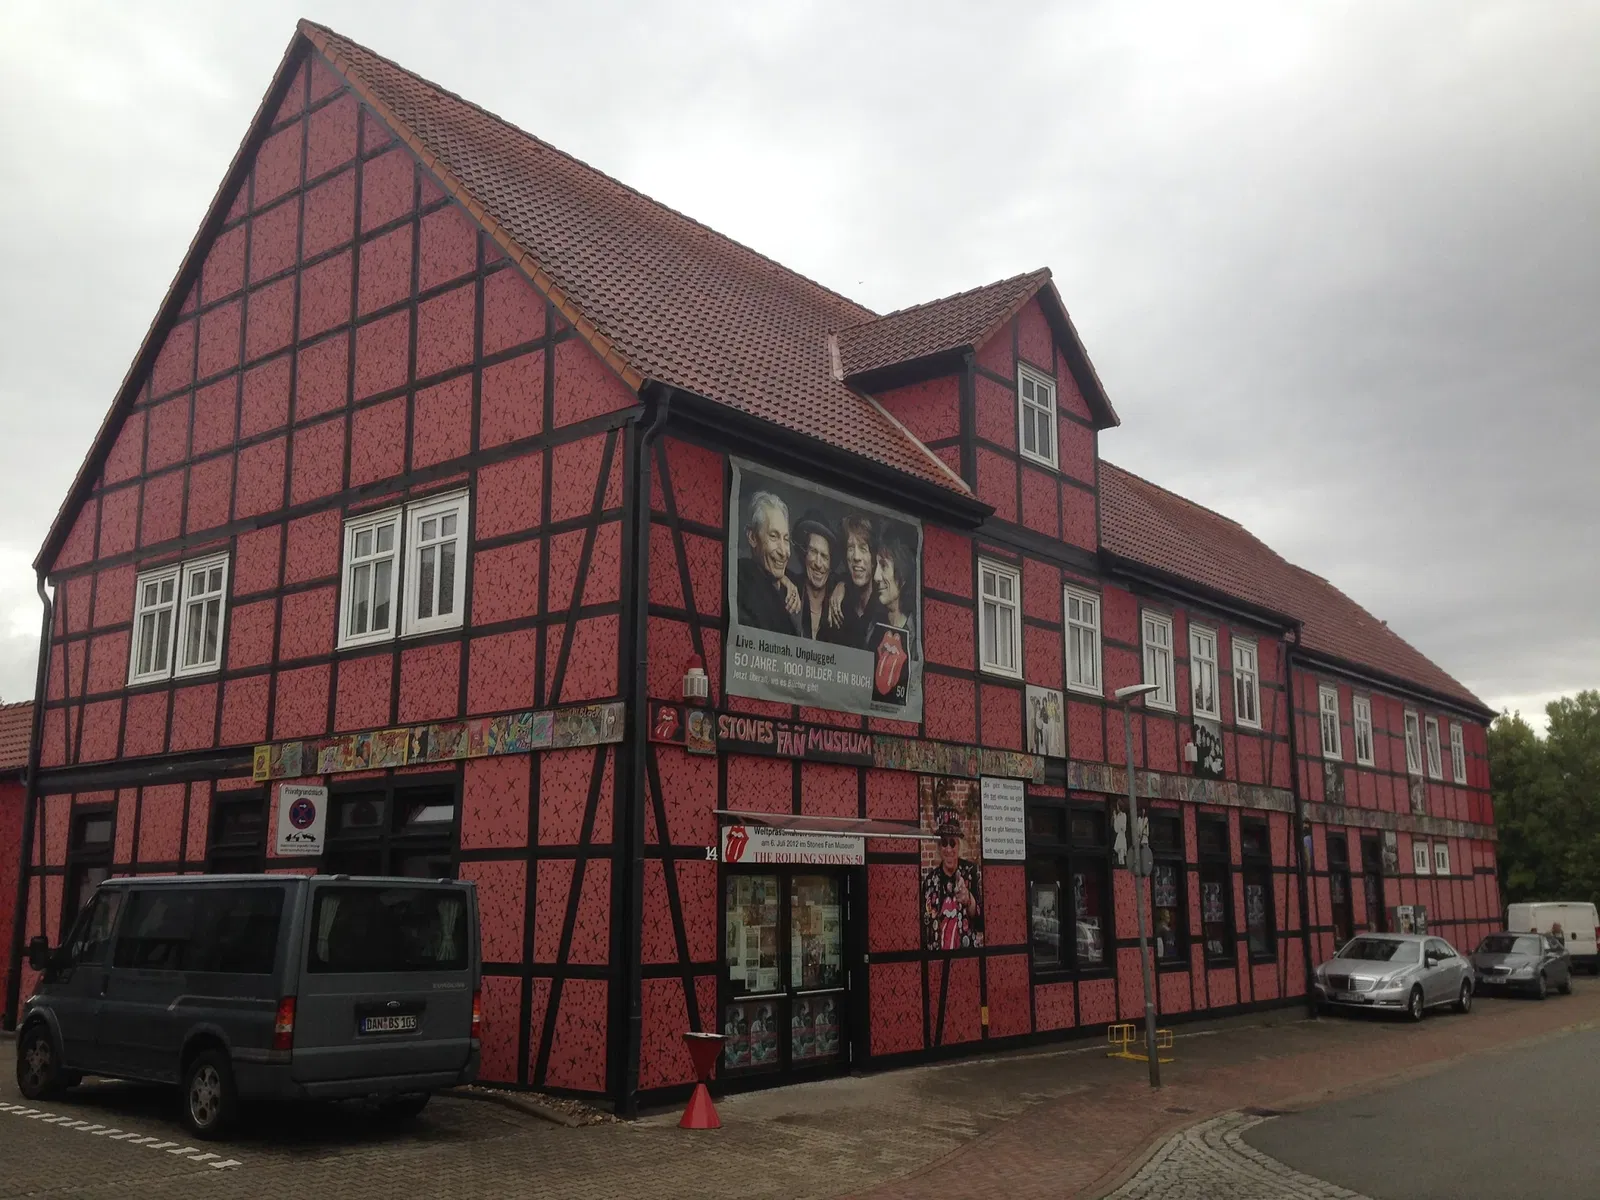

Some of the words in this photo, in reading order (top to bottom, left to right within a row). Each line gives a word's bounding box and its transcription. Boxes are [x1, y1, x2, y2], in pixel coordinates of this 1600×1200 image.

[735, 634, 756, 650] Live.
[758, 639, 793, 658] Hautnah.
[795, 647, 837, 667] Unplugged.
[734, 652, 748, 667] 50
[750, 655, 779, 673] JAHRE.
[783, 661, 803, 676] 1000
[805, 665, 835, 682] BILDER.
[837, 672, 849, 685] EIN
[851, 674, 872, 689] BUCH.
[732, 669, 748, 680] Jetzt
[779, 679, 787, 687] es
[896, 685, 905, 698] 50
[718, 714, 774, 744] STONES
[776, 730, 807, 757] FAN
[808, 727, 872, 755] MUSEUM
[284, 787, 324, 797] Privatgrundstück
[786, 840, 799, 848] 2012
[807, 840, 824, 849] Stones
[825, 841, 834, 849] Fan
[835, 841, 856, 850] Museum
[705, 846, 718, 861] 14
[754, 851, 772, 863] THE
[775, 852, 817, 864] ROLLING
[818, 853, 853, 865] STONES:
[855, 855, 863, 865] 50
[366, 1018, 383, 1030] DAN
[389, 1017, 400, 1029] BS
[401, 1016, 416, 1028] 103
